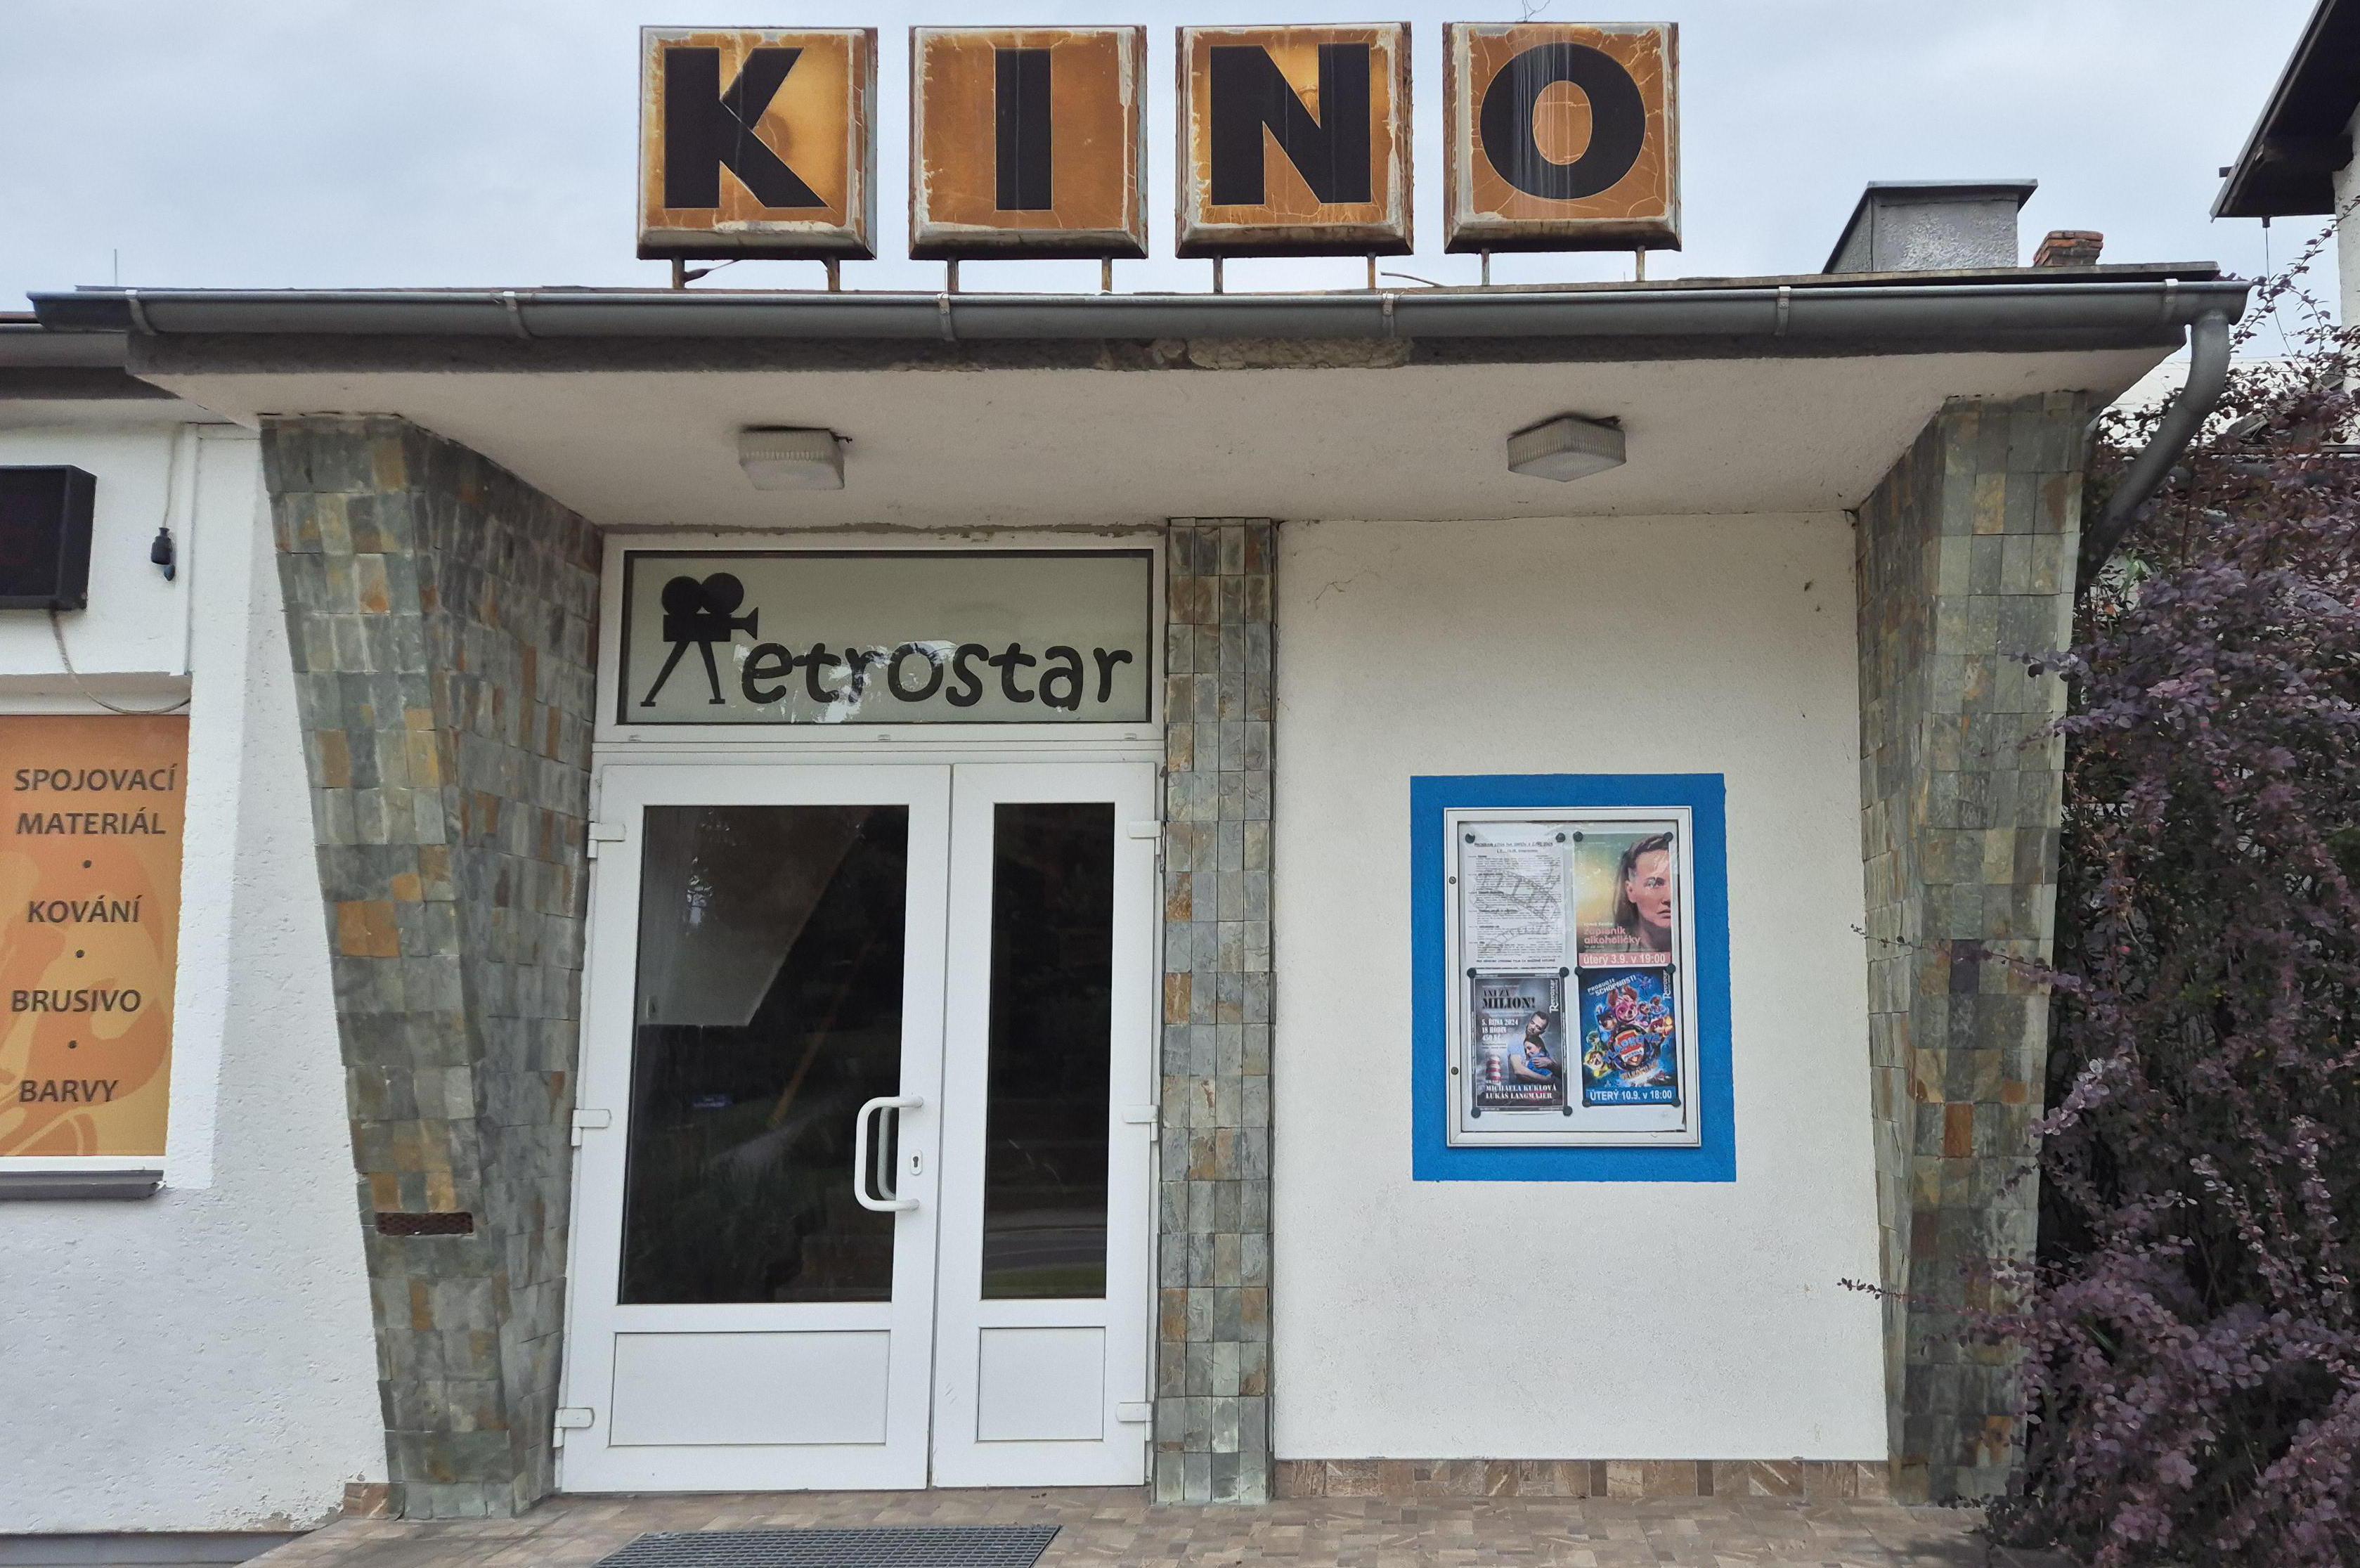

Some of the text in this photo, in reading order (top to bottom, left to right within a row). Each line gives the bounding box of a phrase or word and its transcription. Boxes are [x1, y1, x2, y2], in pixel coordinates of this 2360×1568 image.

[663, 42, 1646, 211] KINO
[14, 763, 178, 791] SPOJOVACÍ
[16, 807, 167, 835] MATERIÁL
[27, 895, 143, 923] KOVÁNÍ
[1583, 954, 1609, 966] úterý
[1611, 954, 1628, 964] 3.9.
[1640, 953, 1666, 964] 19:00
[11, 989, 141, 1012] BRUSIVO
[19, 1080, 119, 1103] BARVY
[1590, 1089, 1619, 1101] ÚTERÝ
[1621, 1091, 1640, 1100] 10.9.
[1649, 1090, 1672, 1099] 18:00
